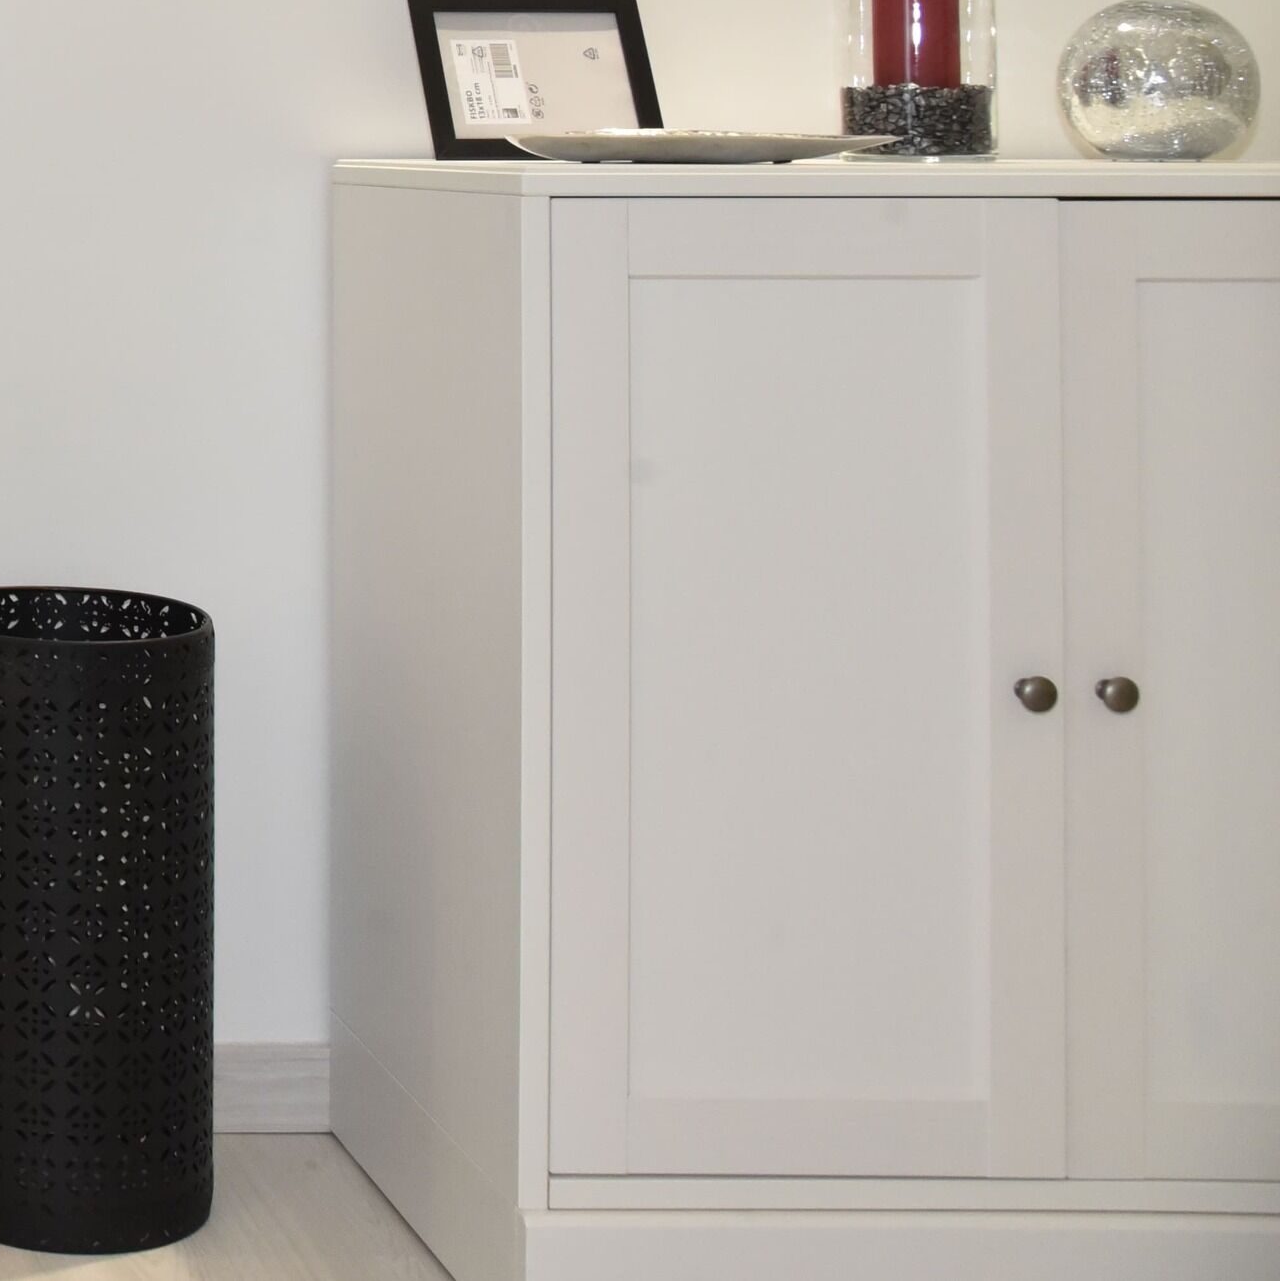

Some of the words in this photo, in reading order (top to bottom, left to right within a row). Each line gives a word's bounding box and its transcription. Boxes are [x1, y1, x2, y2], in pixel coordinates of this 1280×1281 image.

[474, 82, 482, 95] cm
[466, 90, 477, 120] FISKBO
[476, 96, 486, 119] 13x18
